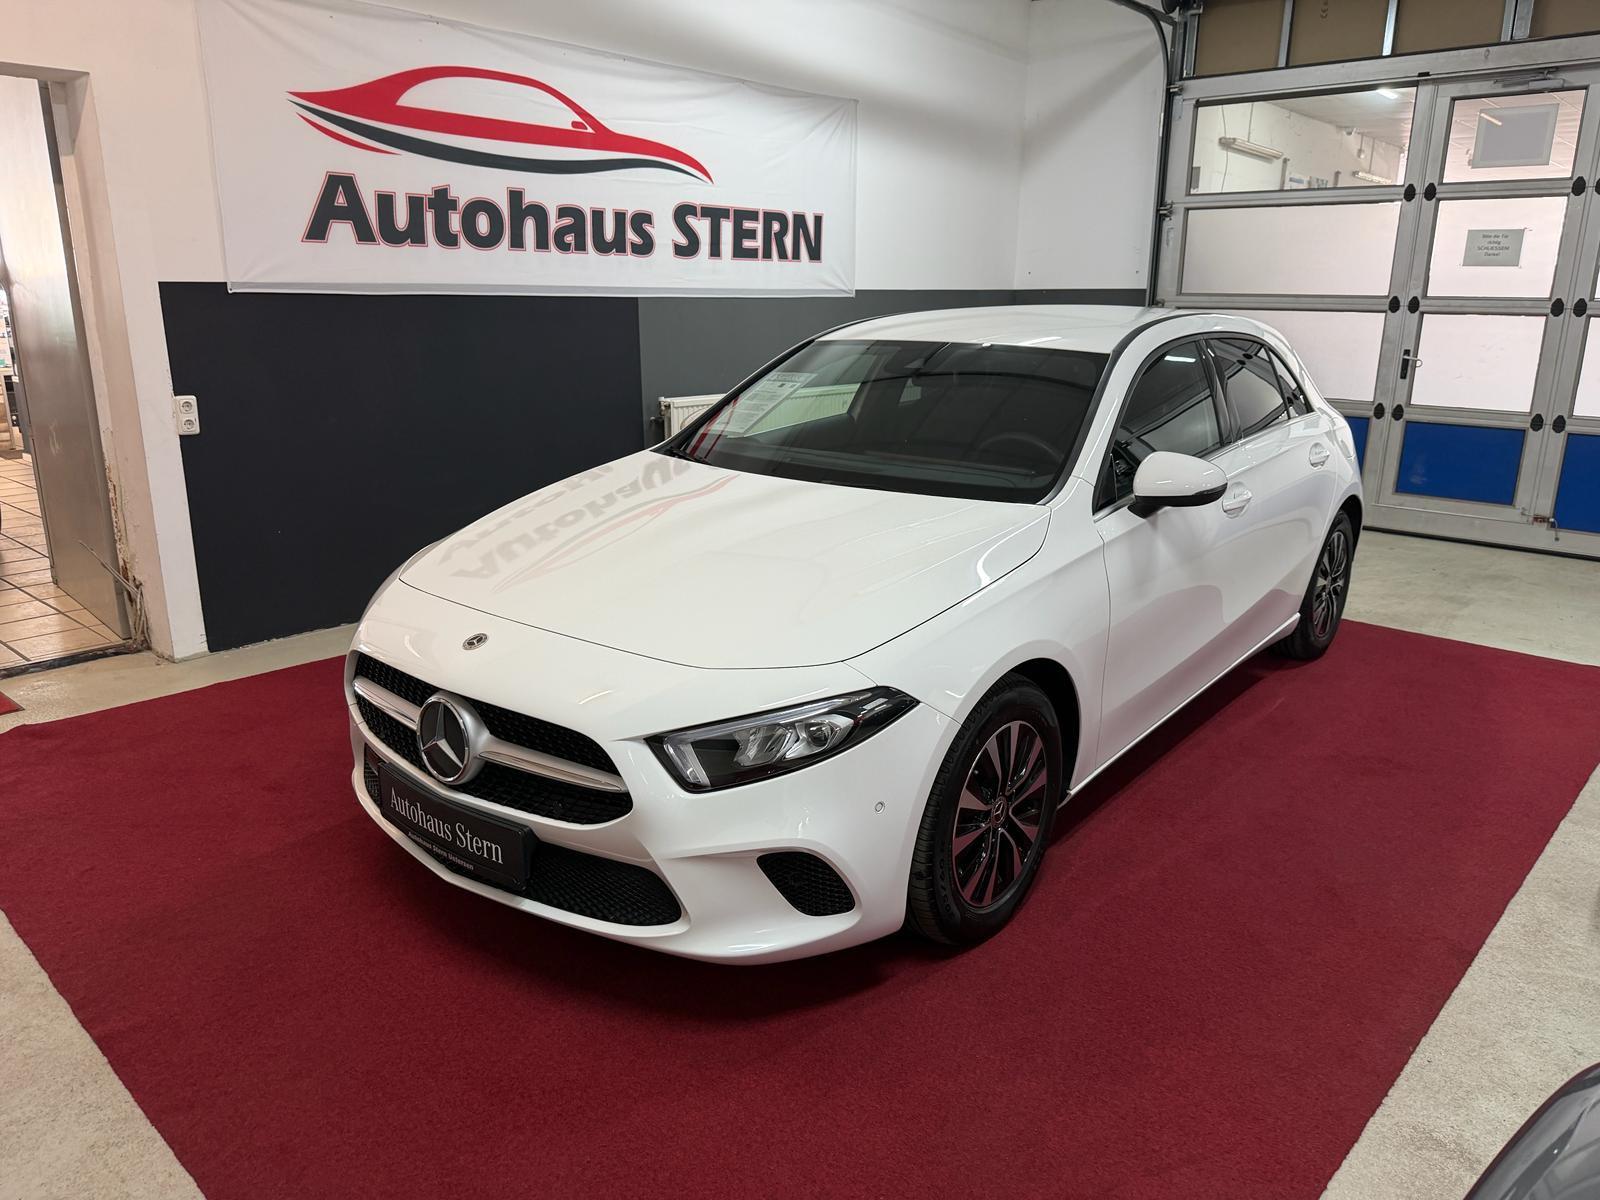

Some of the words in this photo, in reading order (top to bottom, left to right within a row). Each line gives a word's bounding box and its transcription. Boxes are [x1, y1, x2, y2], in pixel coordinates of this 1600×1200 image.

[301, 171, 656, 259] Autohaus
[671, 203, 825, 264] STERN
[390, 787, 453, 842] Autohaus
[455, 822, 504, 865] Stern
[408, 831, 432, 849] Autohaus
[432, 845, 448, 858] Stern
[447, 853, 474, 871] Uetersen
